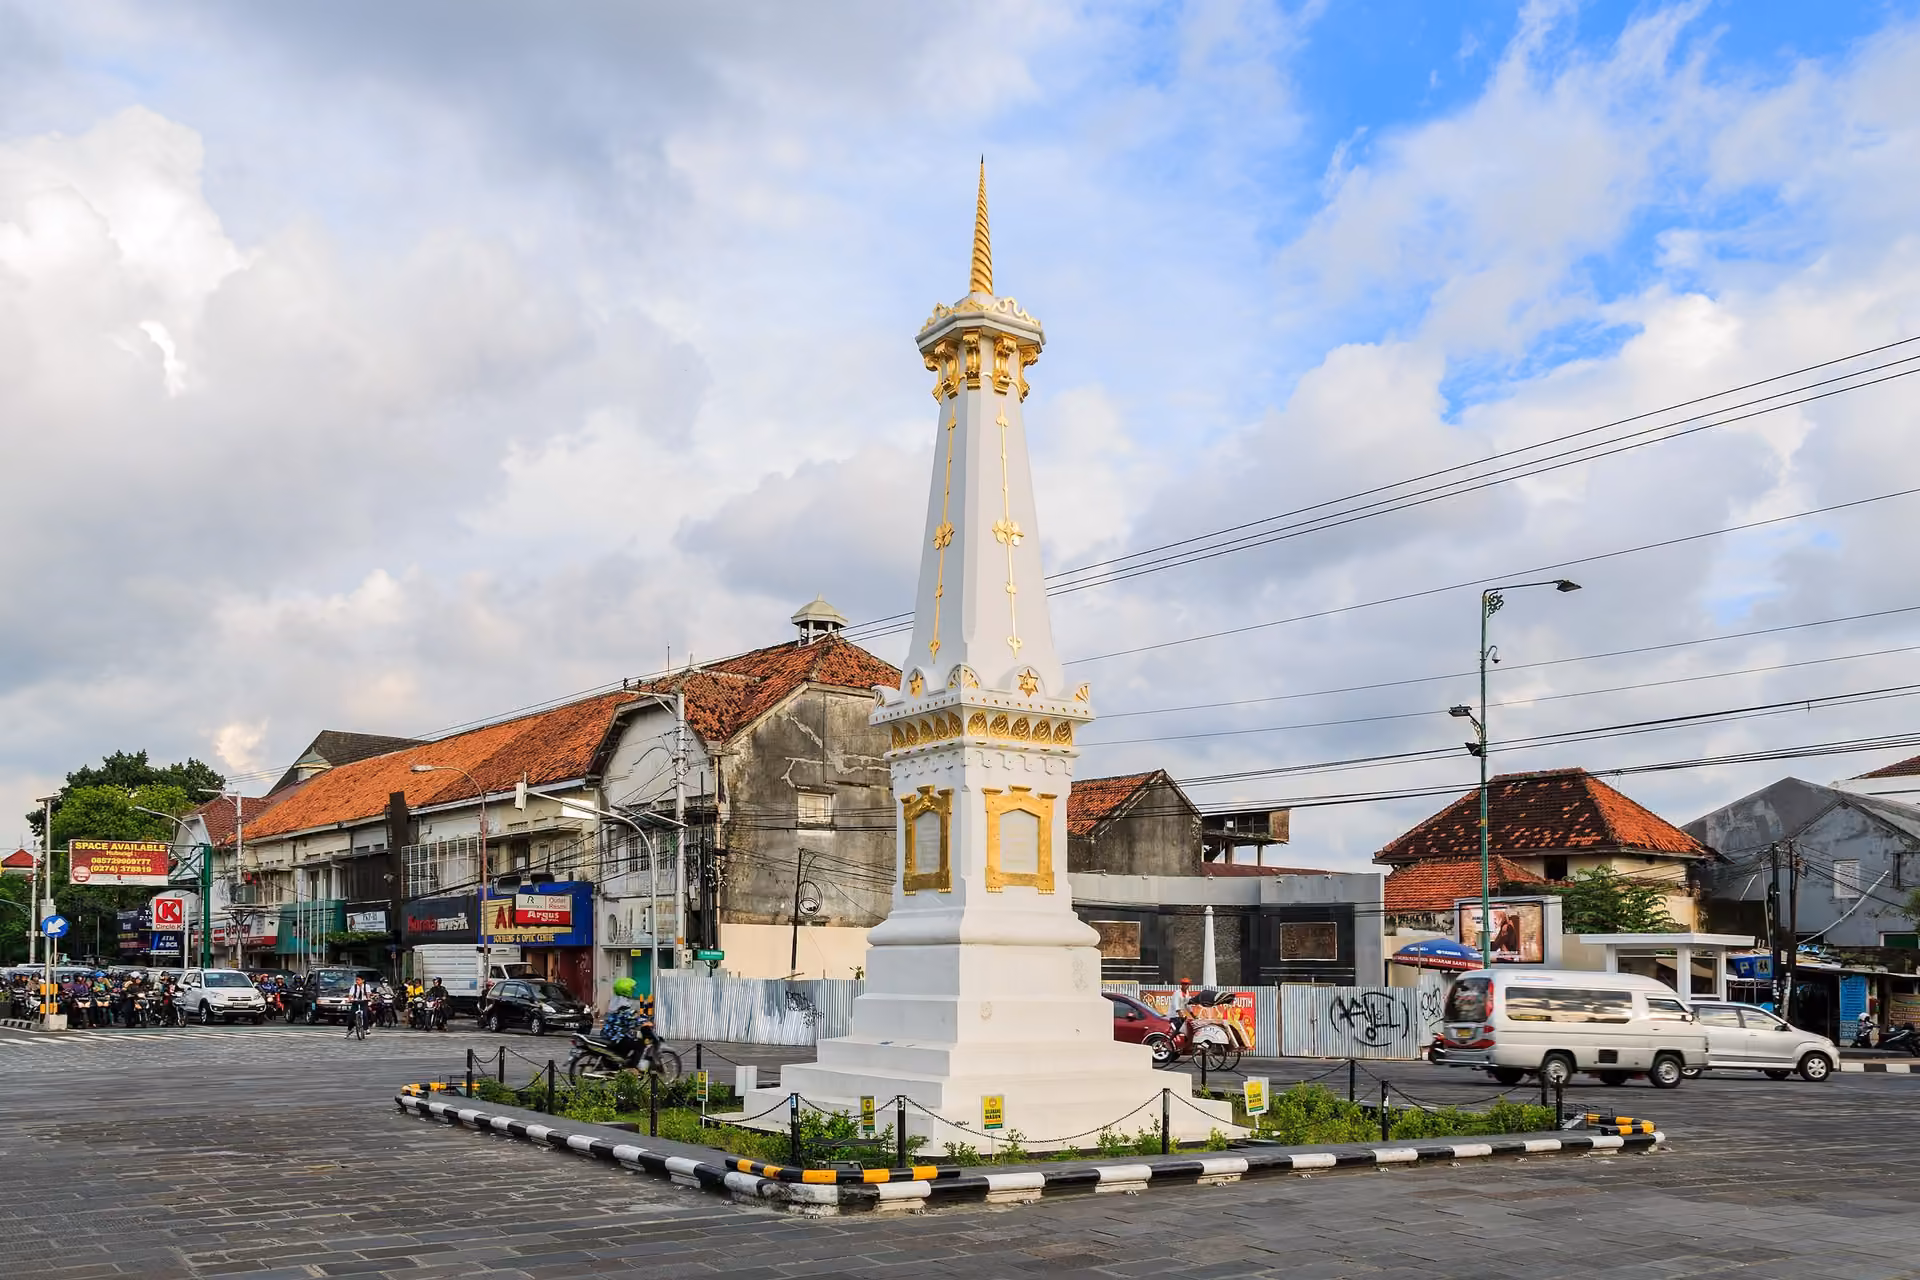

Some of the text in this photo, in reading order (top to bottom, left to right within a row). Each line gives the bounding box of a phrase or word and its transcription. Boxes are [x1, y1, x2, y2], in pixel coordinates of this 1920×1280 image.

[75, 842, 166, 852] SPACE AVAILABLE
[527, 910, 560, 920] Argus
[521, 934, 537, 942] OPTIC
